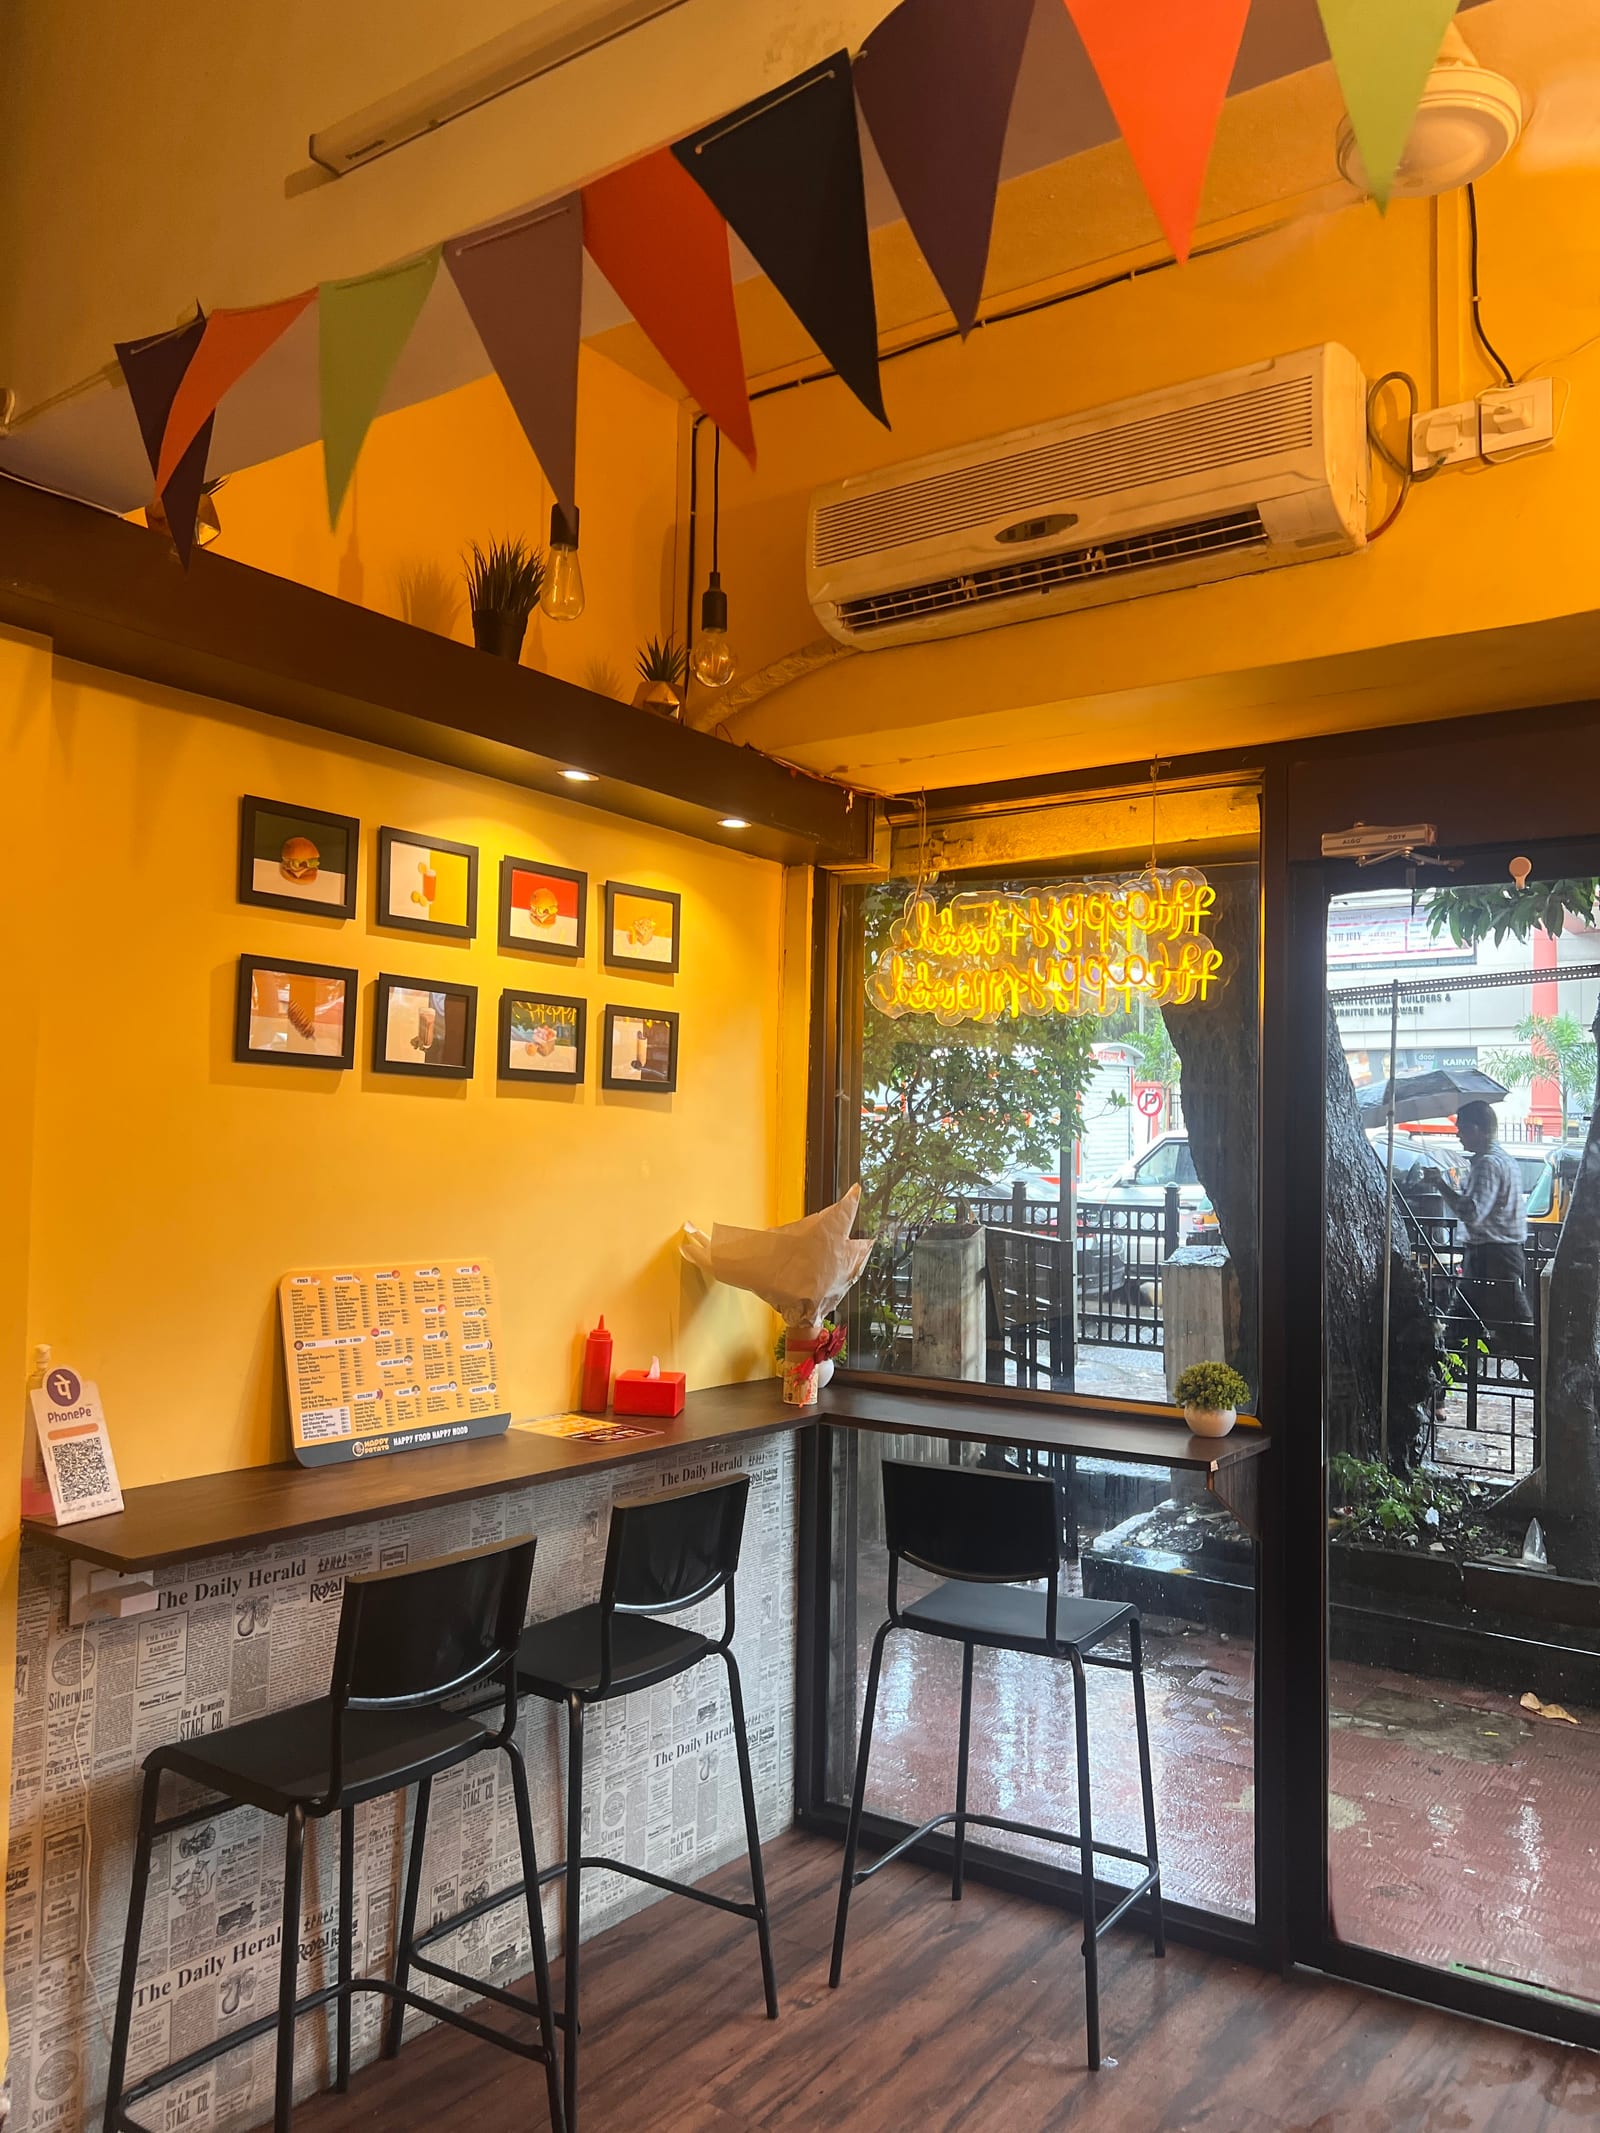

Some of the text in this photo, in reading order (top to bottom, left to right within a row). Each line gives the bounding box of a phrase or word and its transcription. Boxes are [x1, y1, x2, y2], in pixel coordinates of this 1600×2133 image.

[1333, 994, 1393, 1007] RCHITECTURA
[1401, 993, 1442, 1005] BUILDERS
[1335, 1006, 1424, 1017] URNITURE HARWARE
[1418, 1053, 1435, 1061] door
[48, 1407, 92, 1424] PhonePe
[393, 1435, 413, 1447] HAPPY
[415, 1431, 431, 1444] FOOD
[432, 1428, 451, 1439] HAPPY
[660, 1455, 743, 1487] The Daily Herald
[156, 1559, 307, 1612] The Daily Herald
[212, 1710, 224, 1731] CO.
[653, 1752, 674, 1768] The
[676, 1737, 702, 1758] Daily
[135, 1926, 282, 2009] The Daily Heral
